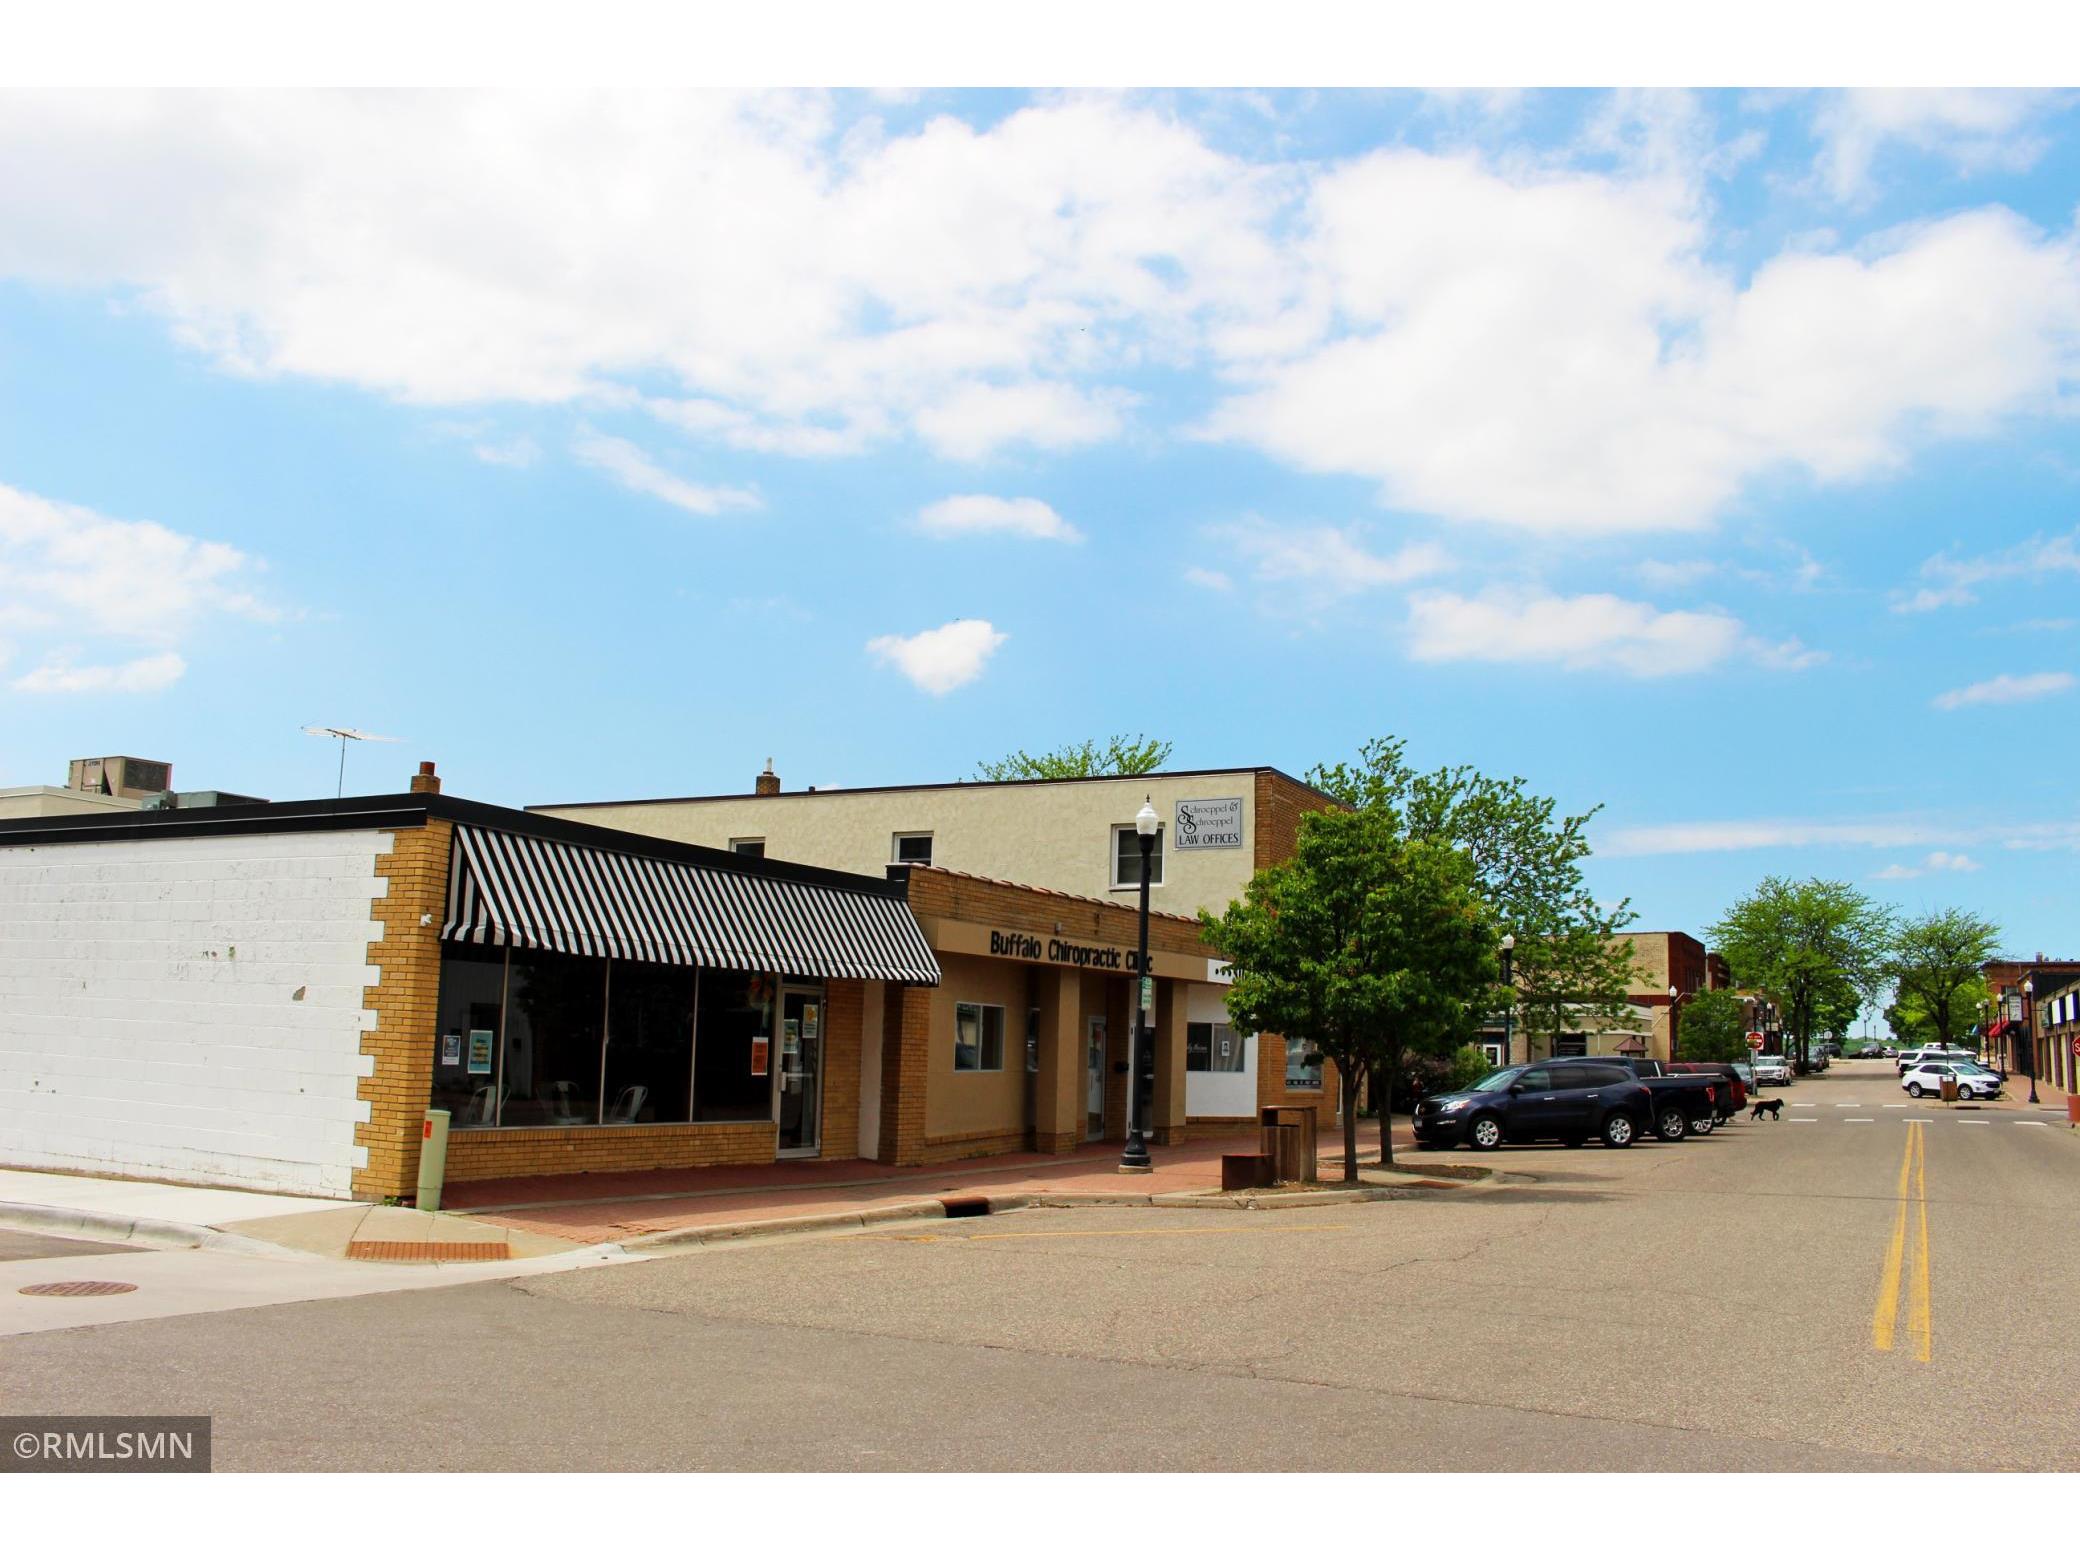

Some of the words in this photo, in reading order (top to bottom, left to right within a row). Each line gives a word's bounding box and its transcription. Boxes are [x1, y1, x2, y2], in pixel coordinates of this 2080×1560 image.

[1178, 803, 1227, 825] Schroeppel
[1229, 802, 1239, 812] &
[1183, 815, 1233, 835] Schroeppel
[1179, 834, 1199, 845] LAW
[1203, 832, 1239, 845] OFFICES
[990, 930, 1042, 960] Buffalo
[1048, 939, 1121, 969] Chiropractic
[1125, 950, 1153, 973] Clic
